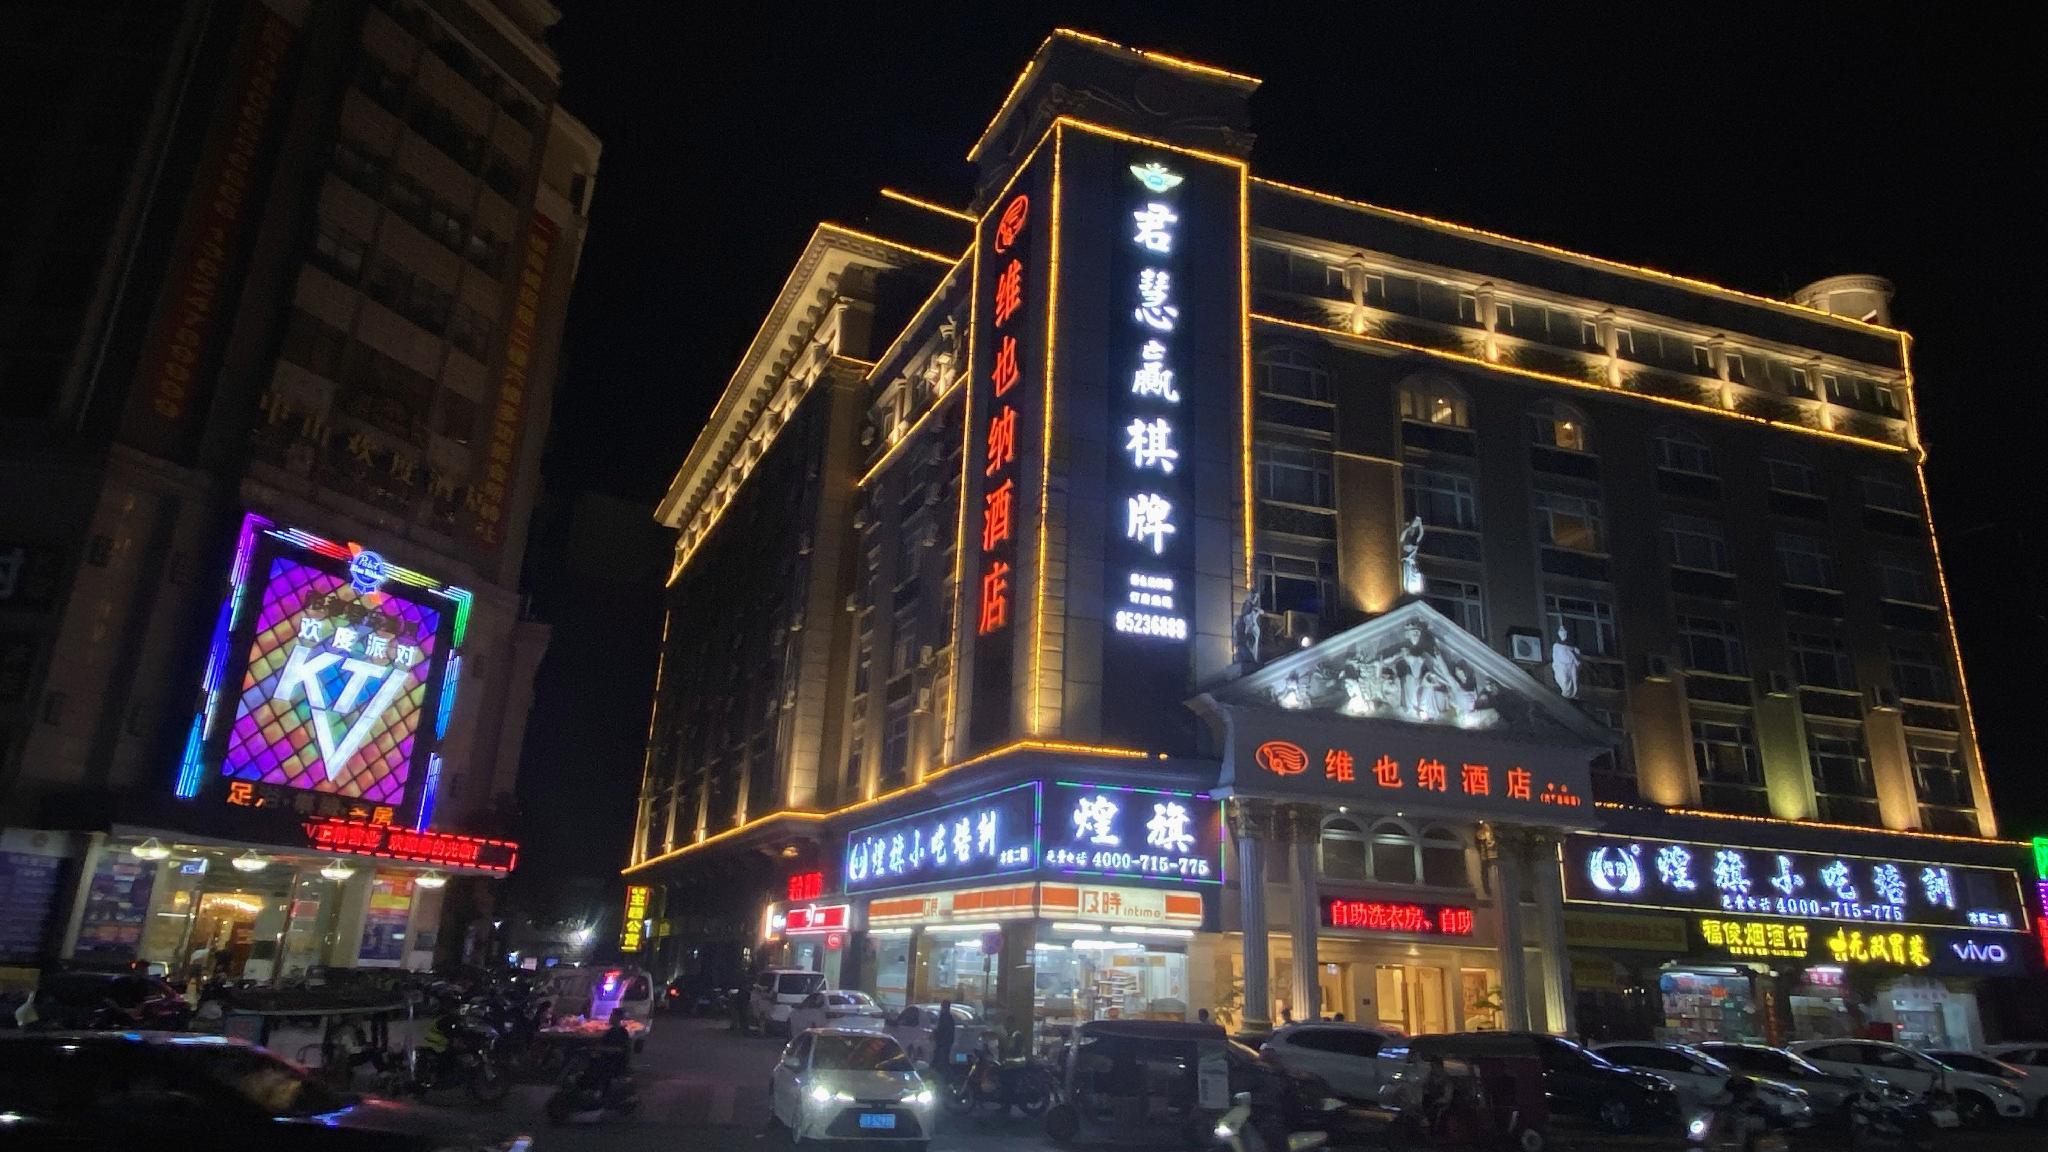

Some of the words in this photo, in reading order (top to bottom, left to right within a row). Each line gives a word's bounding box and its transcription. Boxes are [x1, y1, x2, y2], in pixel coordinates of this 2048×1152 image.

[978, 258, 1022, 636] 维也纳酒店
[273, 645, 408, 782] KTV
[1324, 748, 1531, 801] 维也纳酒店
[1073, 795, 1196, 853] 煌旗
[1091, 851, 1210, 876] 4000-715-775
[1776, 896, 1903, 922] 4000-715-775
[1953, 940, 2005, 962] vivo
